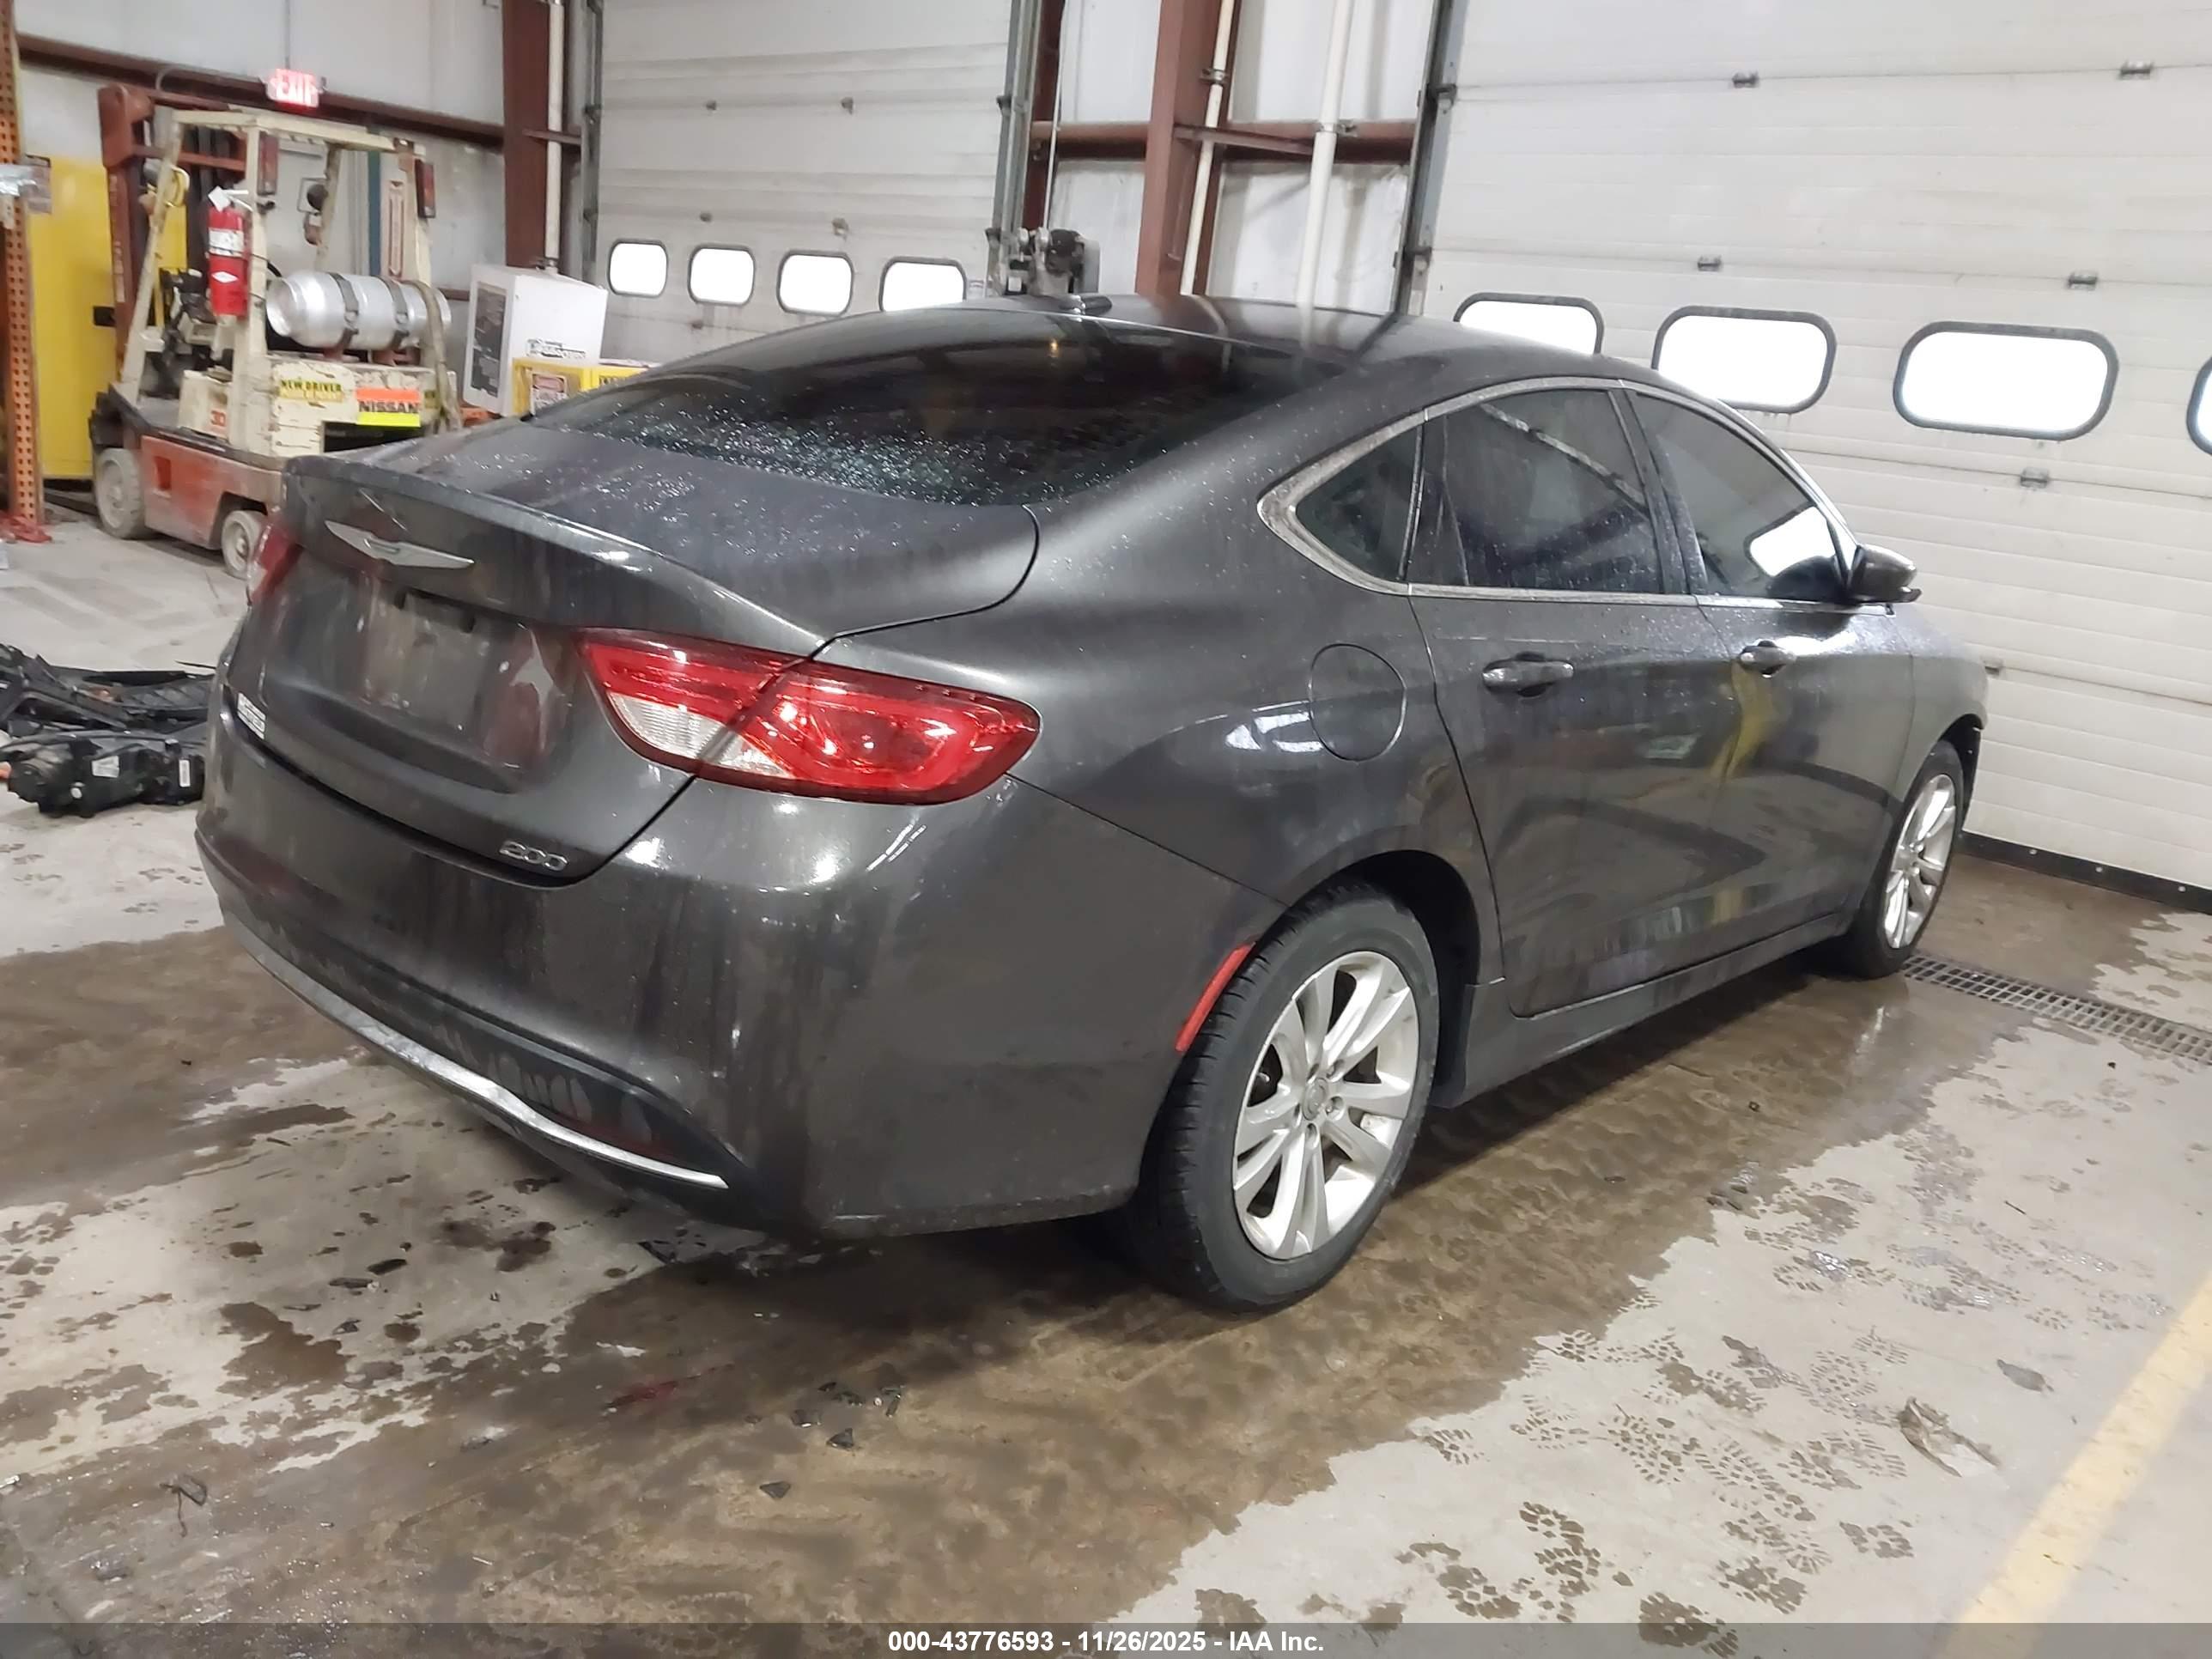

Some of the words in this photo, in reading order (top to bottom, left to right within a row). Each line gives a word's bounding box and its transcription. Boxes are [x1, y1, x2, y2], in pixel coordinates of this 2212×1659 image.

[275, 70, 318, 106] EXIT
[358, 401, 419, 414] NISSAN
[499, 841, 568, 872] 200
